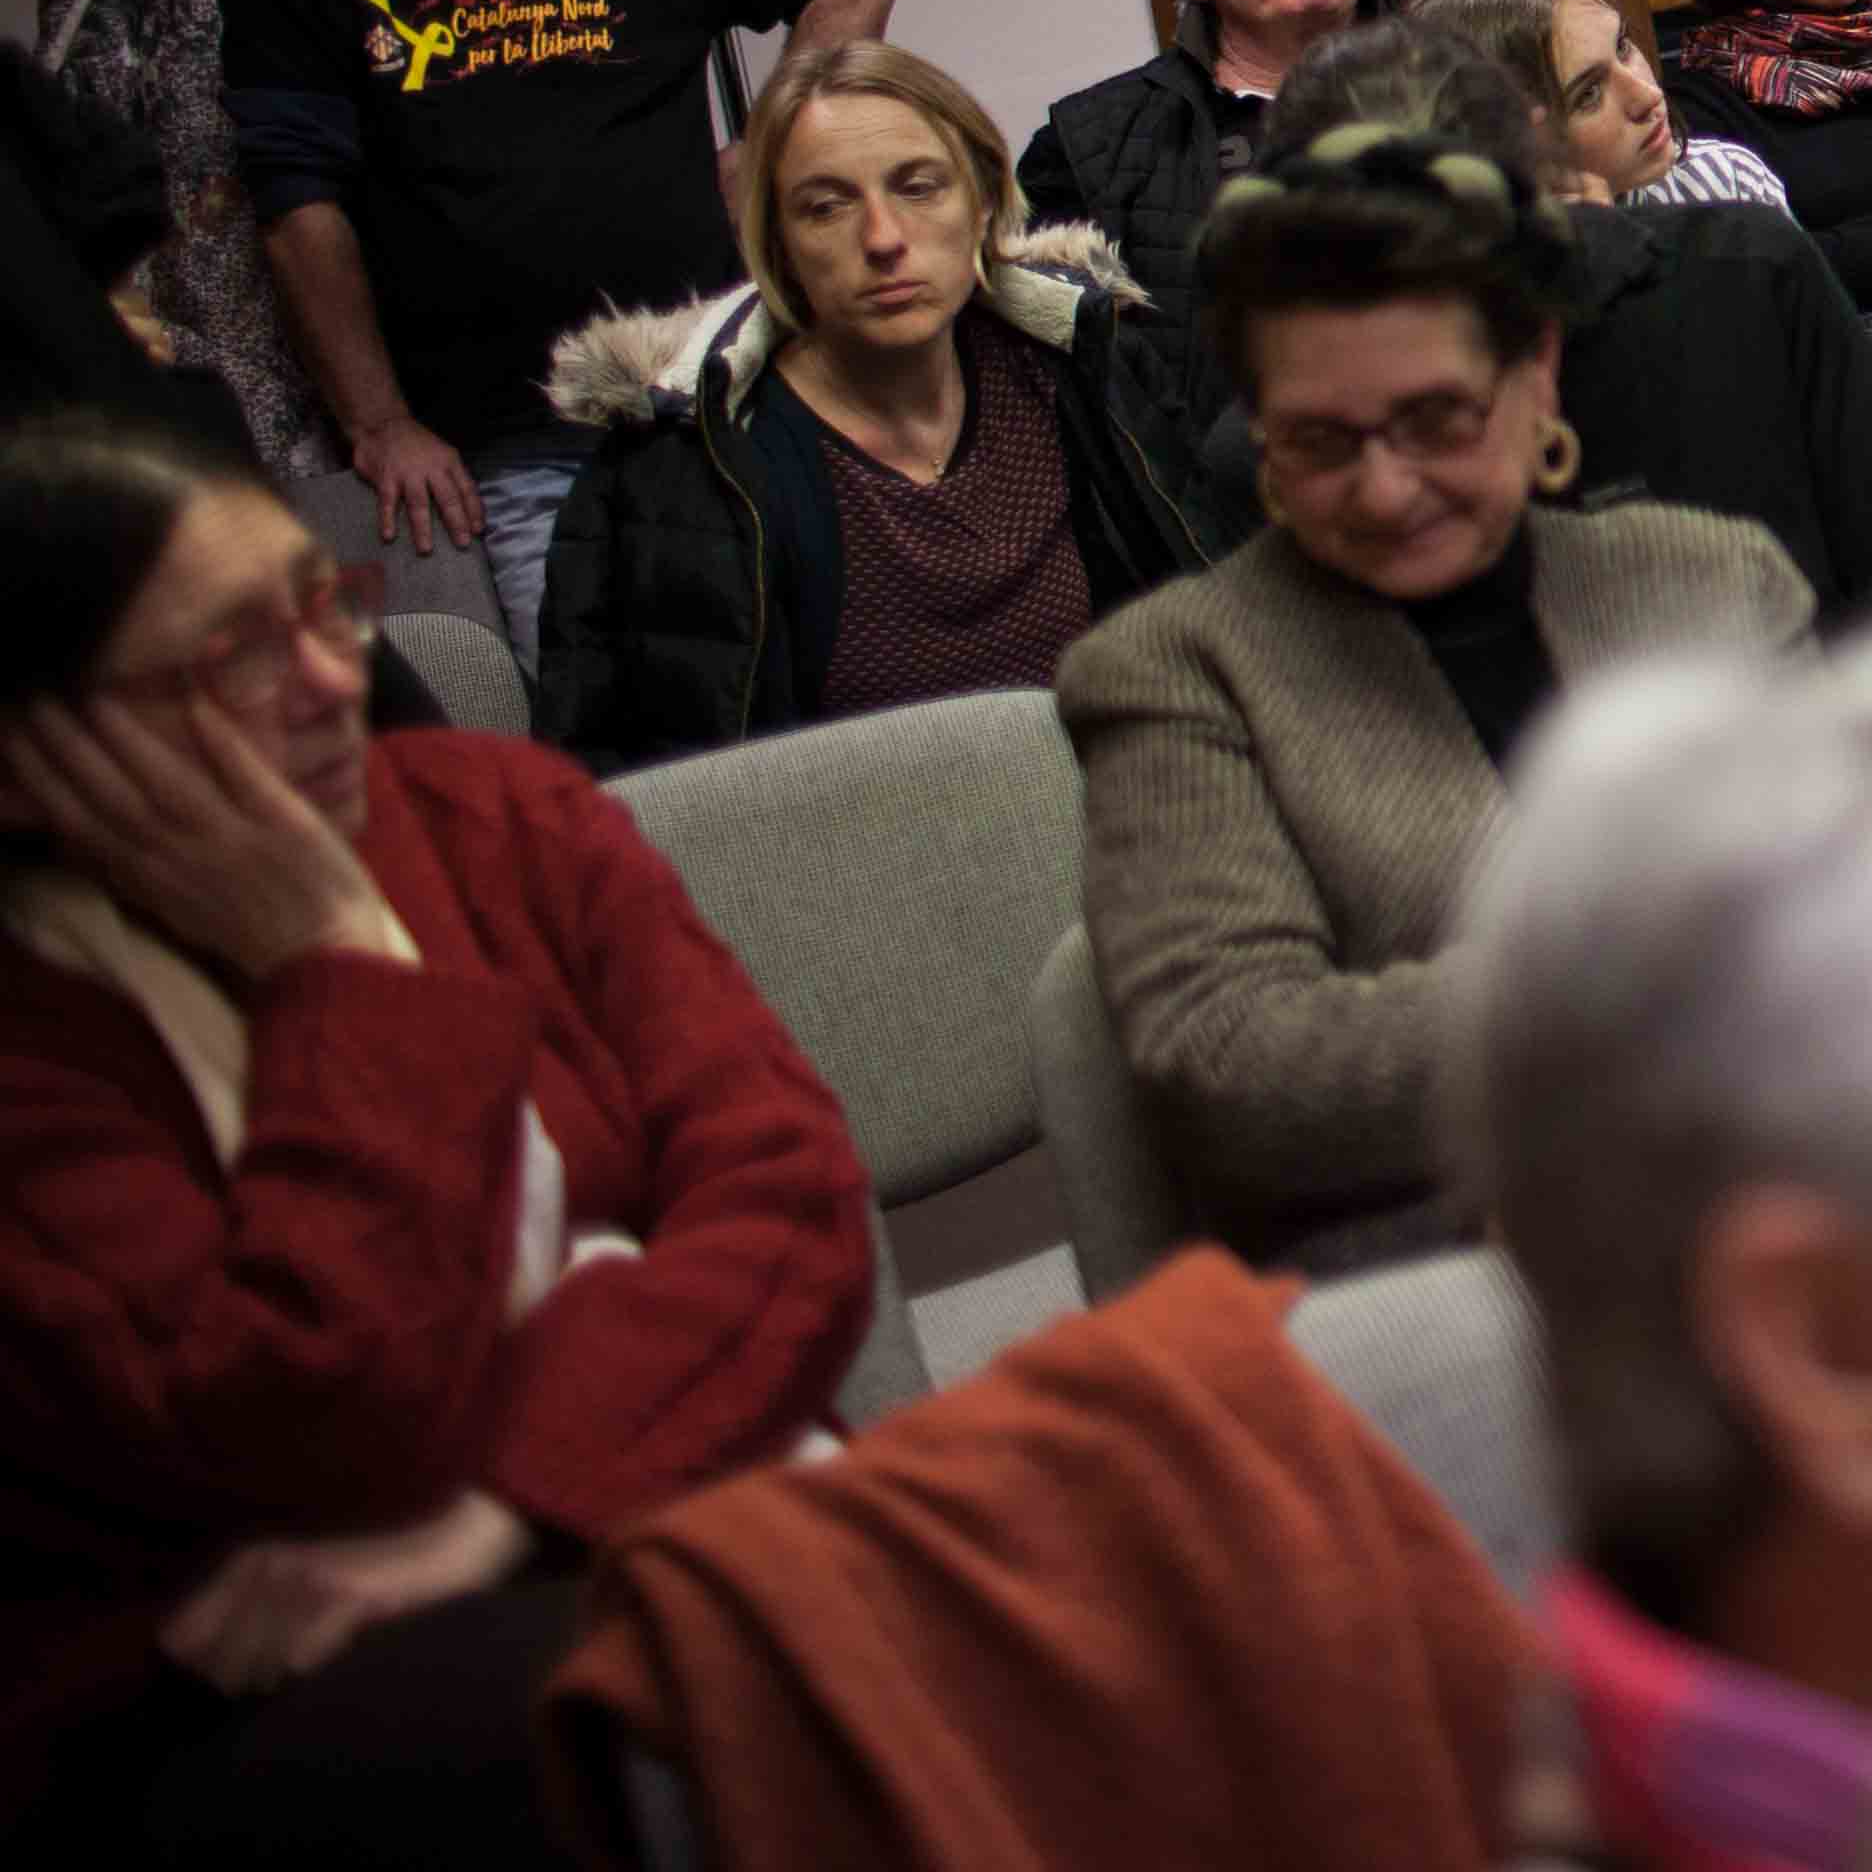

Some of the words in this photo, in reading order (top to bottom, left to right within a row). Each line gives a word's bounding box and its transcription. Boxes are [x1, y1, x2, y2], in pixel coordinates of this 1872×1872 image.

[451, 2, 557, 37] Catalunya
[467, 47, 496, 72] per
[503, 38, 527, 64] la
[530, 27, 614, 62] Llibertat
